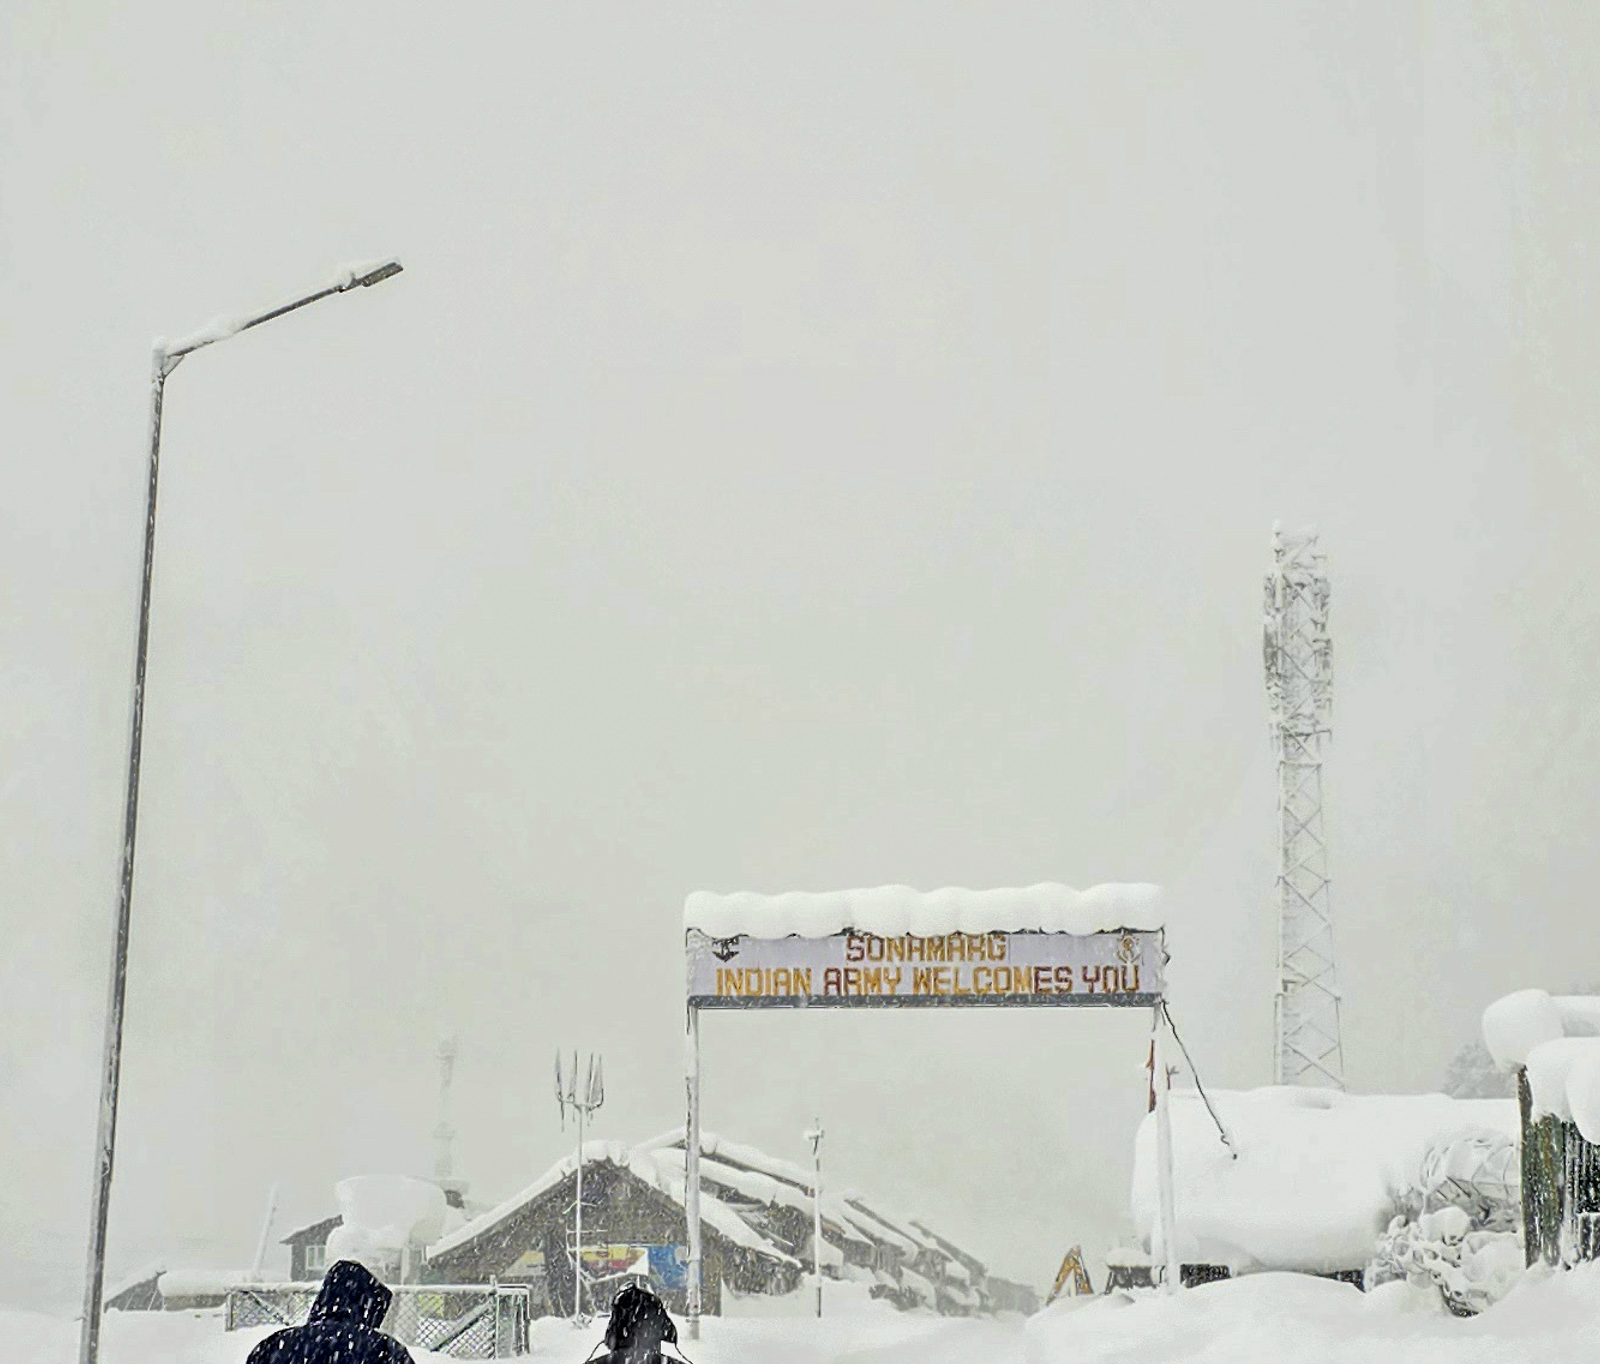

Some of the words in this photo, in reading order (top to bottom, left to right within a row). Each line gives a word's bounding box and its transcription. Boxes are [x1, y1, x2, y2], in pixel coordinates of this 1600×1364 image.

[846, 933, 1007, 963] SONAMARG
[716, 966, 812, 996] INDIAN
[823, 966, 901, 996] ARMY
[912, 965, 1073, 996] WELCOMES
[1081, 964, 1140, 994] YOU
